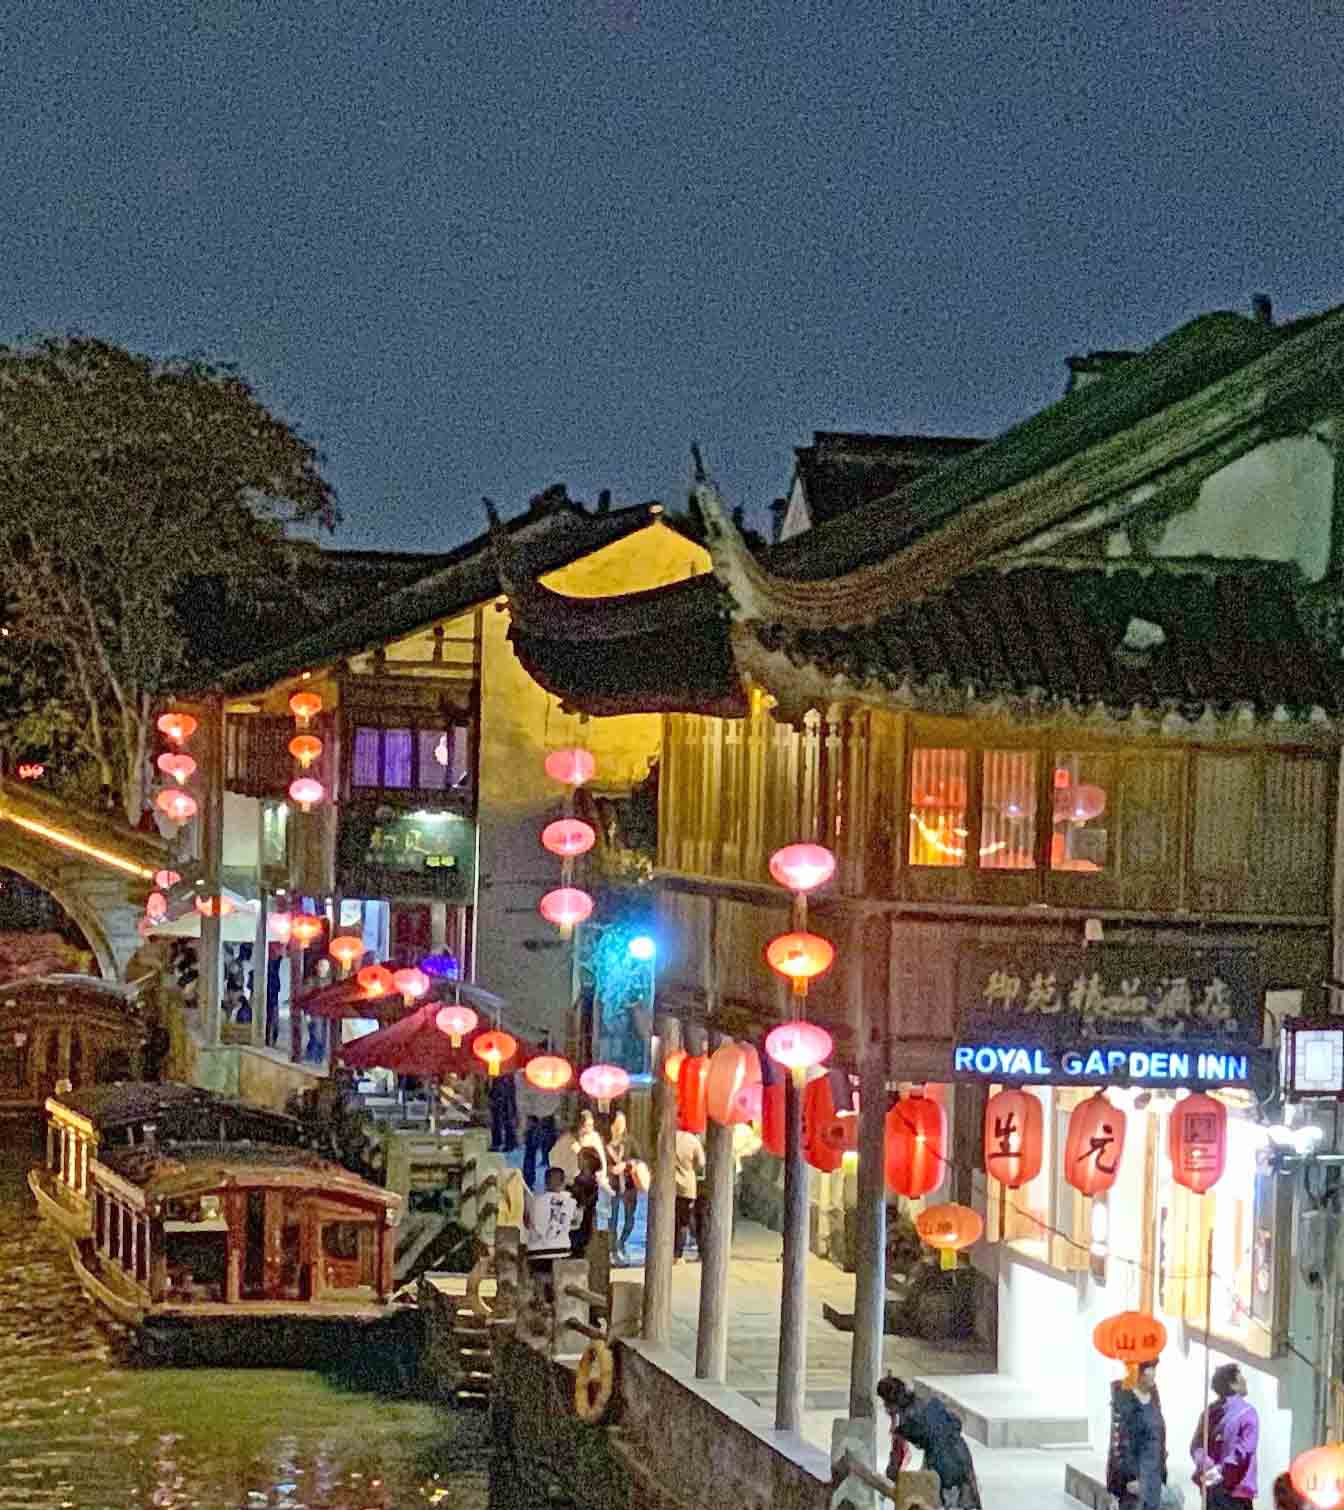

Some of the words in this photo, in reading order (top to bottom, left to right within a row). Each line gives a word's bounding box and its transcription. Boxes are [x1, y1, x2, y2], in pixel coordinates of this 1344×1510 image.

[955, 1047, 1051, 1075] ROYAL
[1061, 1050, 1189, 1079] GARDEN
[1197, 1054, 1248, 1081] INN
